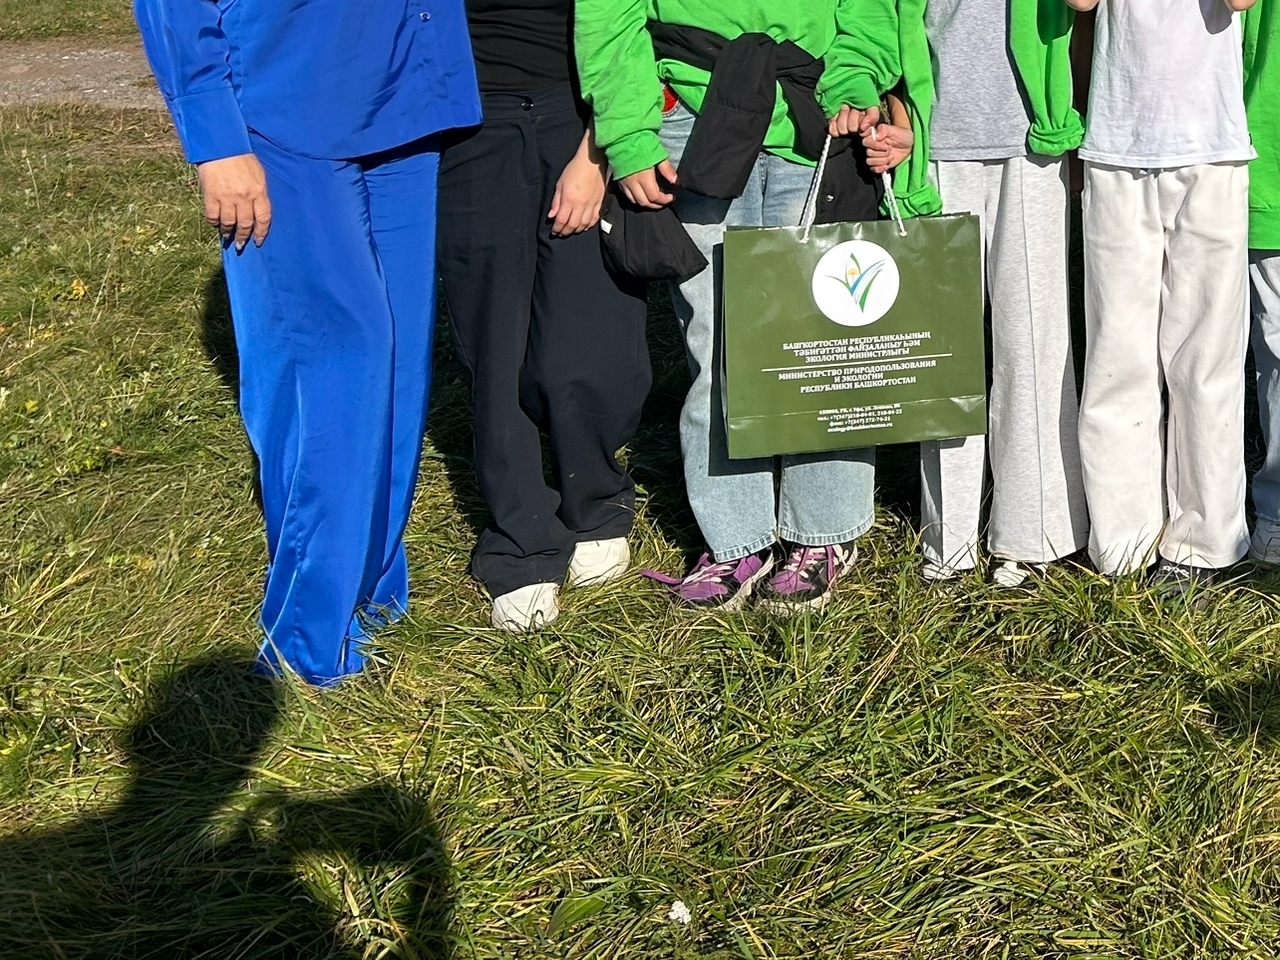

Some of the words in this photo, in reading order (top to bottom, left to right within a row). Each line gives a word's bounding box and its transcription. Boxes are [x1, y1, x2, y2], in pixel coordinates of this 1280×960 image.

[805, 353, 848, 364] ЭКОЛОГИЯ
[778, 368, 843, 381] МИНИСТЕРСТВО
[843, 360, 937, 375] ПРИРОДОПОЛЬЗОВАНИЯ
[841, 372, 884, 383] ЭКОЛОГИИ
[800, 383, 853, 394] РЕСПУБЛИКИ
[854, 376, 917, 389] БАШКОРТОСТАН
